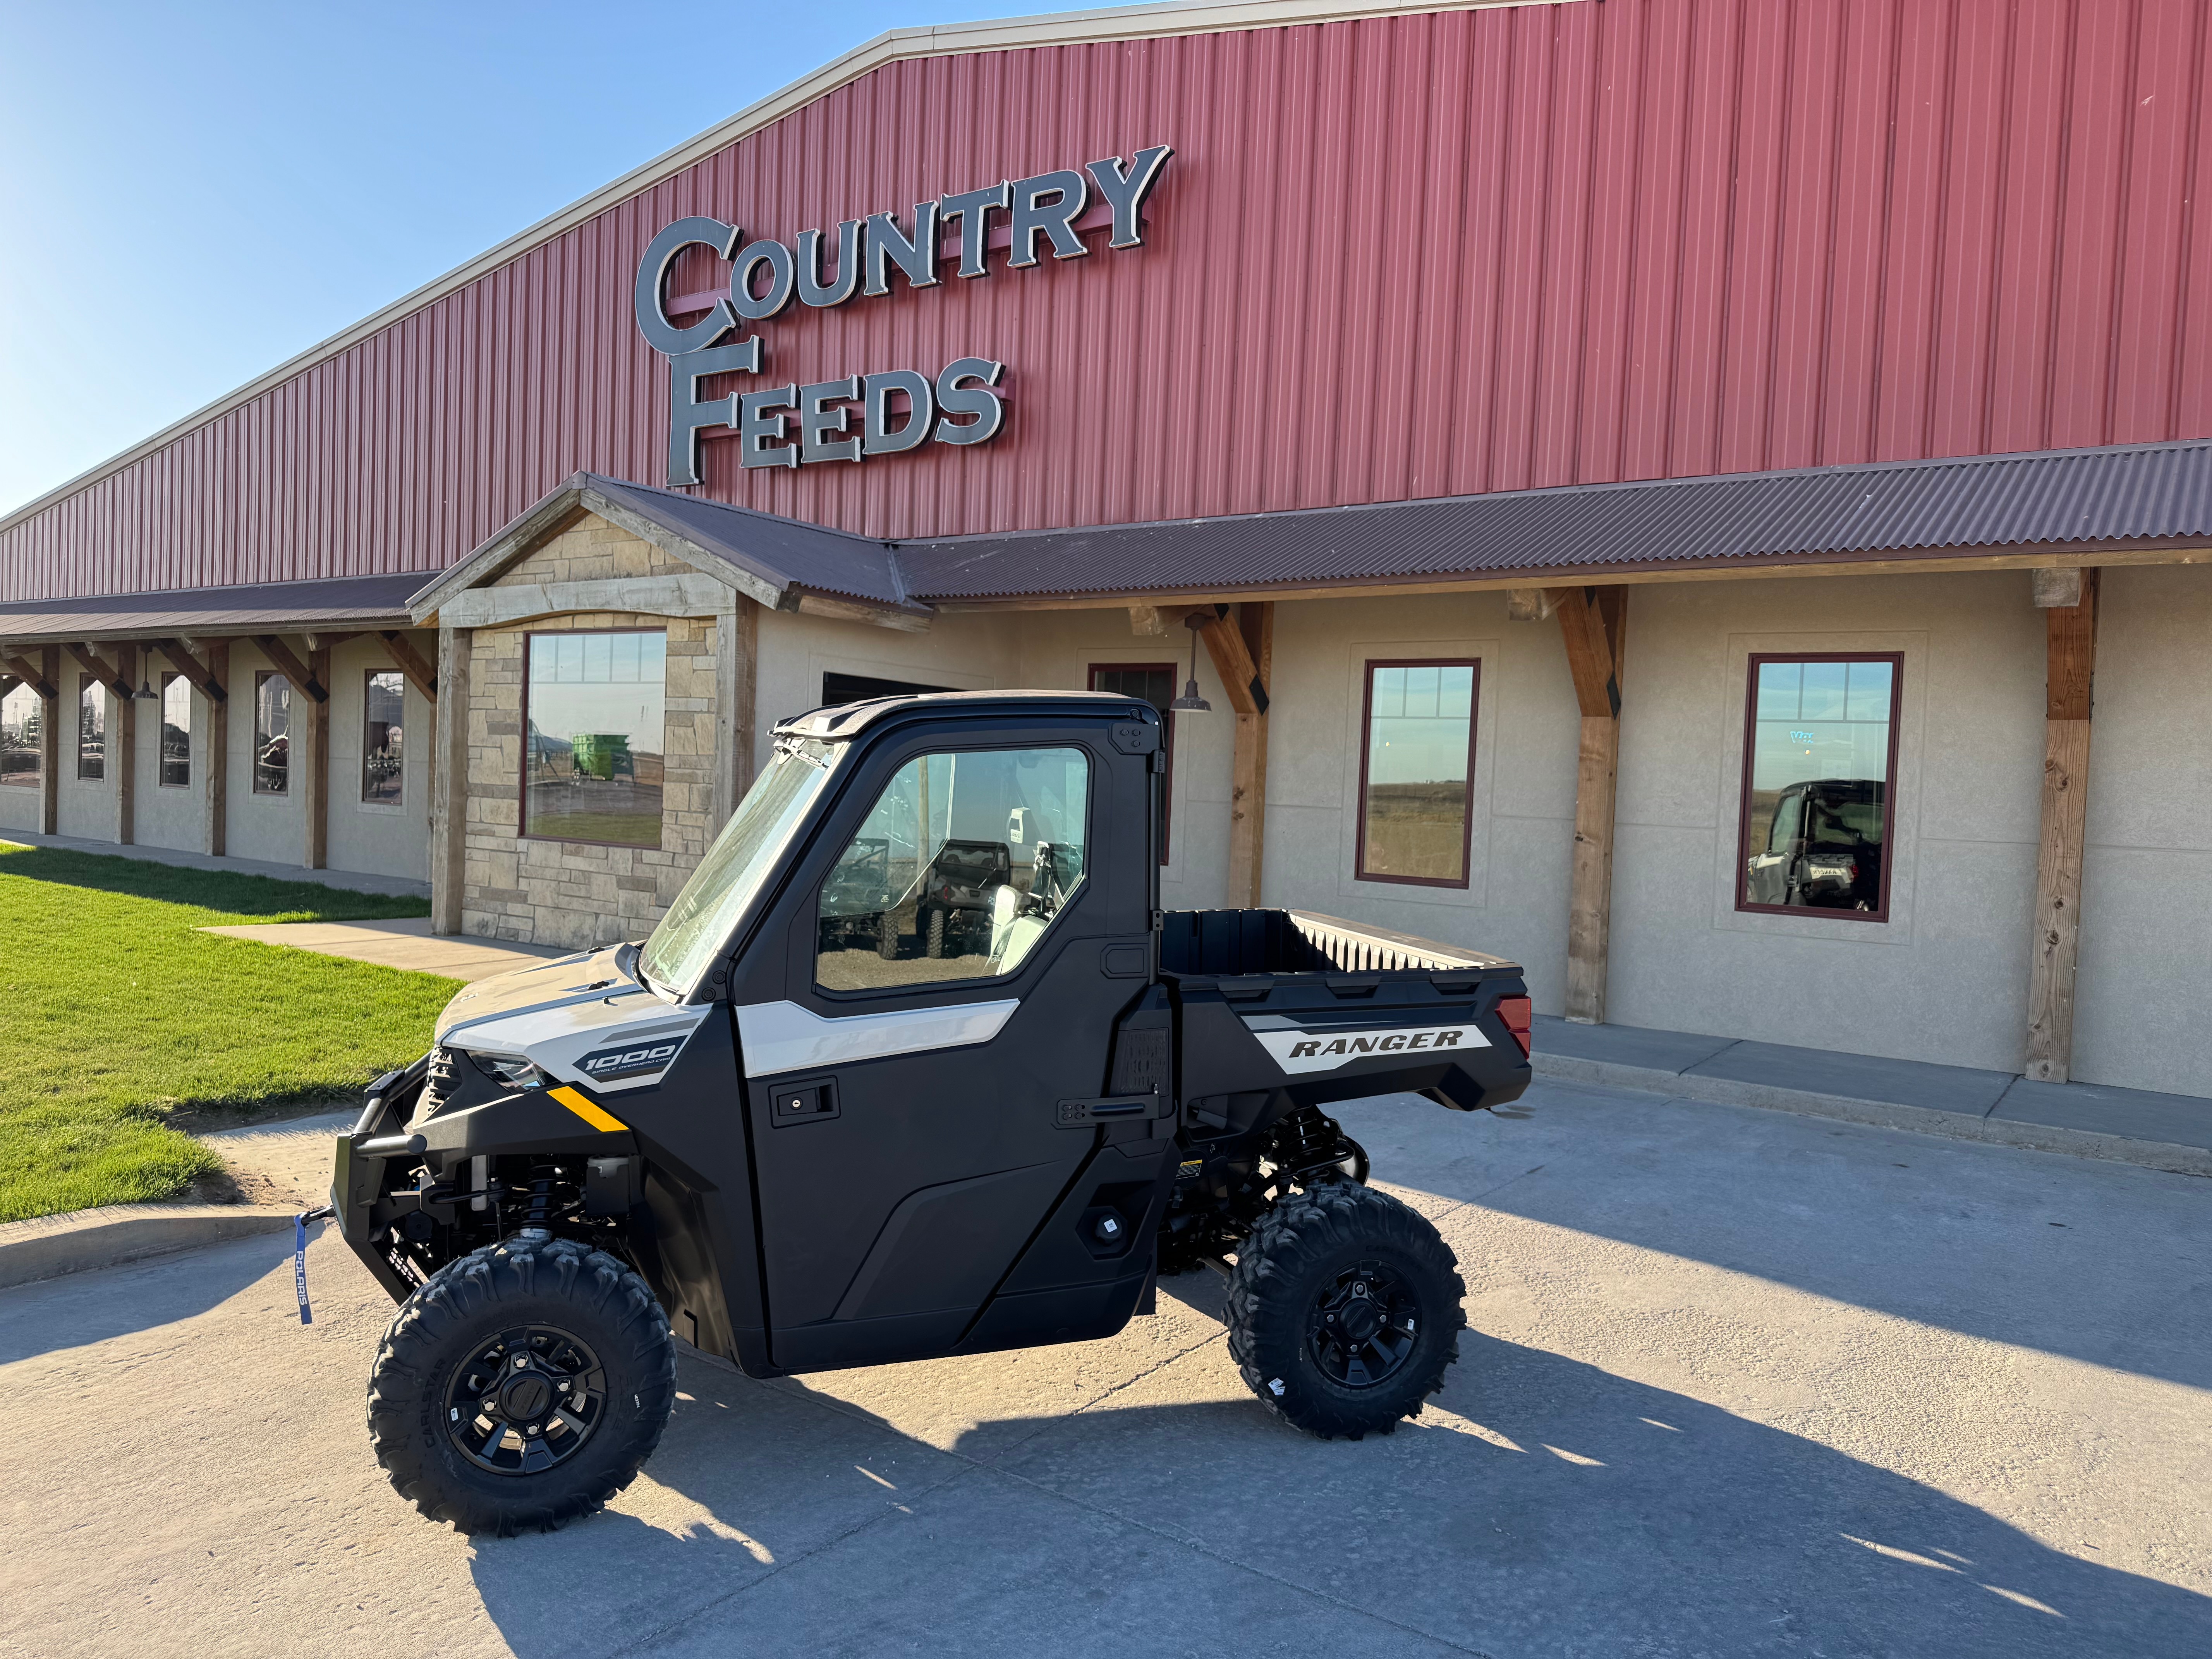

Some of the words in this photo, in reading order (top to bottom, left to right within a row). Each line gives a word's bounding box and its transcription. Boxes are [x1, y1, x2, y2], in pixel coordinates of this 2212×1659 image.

[585, 1045, 676, 1070] 1000
[1288, 1030, 1463, 1058] RANGER
[619, 1060, 654, 1069] OVERHEAD
[296, 1250, 307, 1305] POLARIS
[421, 1358, 446, 1448] CARLSTAR
